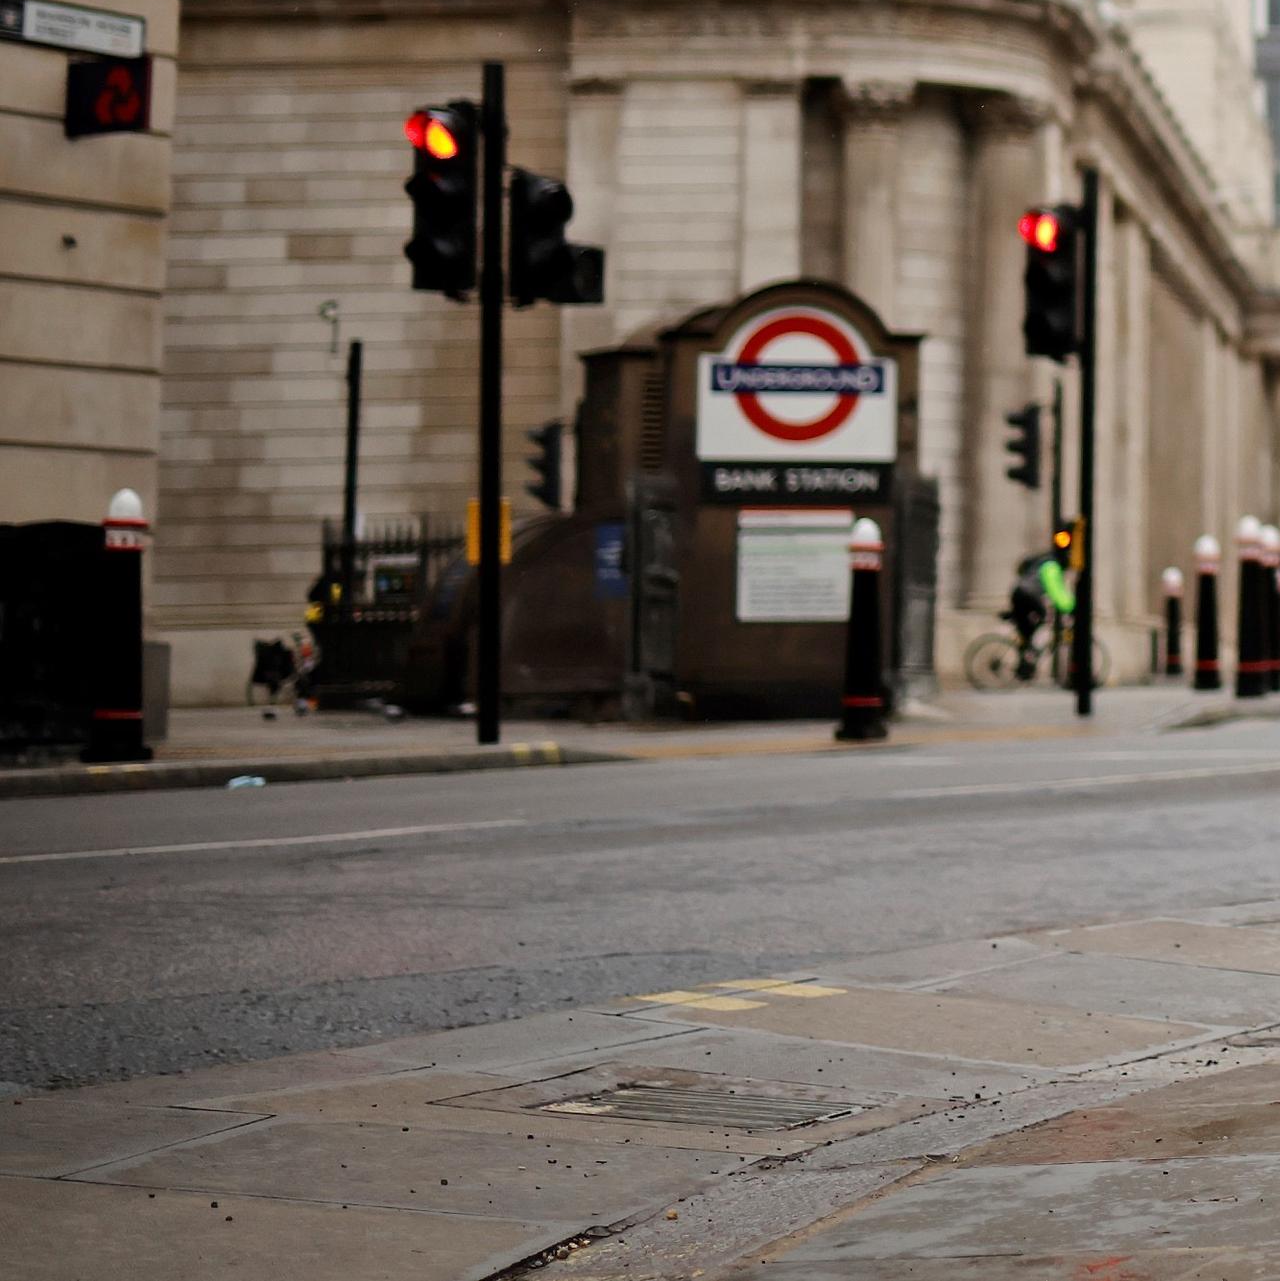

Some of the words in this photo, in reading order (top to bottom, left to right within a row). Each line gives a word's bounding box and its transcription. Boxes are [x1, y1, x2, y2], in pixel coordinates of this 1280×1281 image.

[717, 366, 879, 391] UNDERGROUND
[714, 468, 777, 492] BANK
[785, 468, 880, 492] STATION
